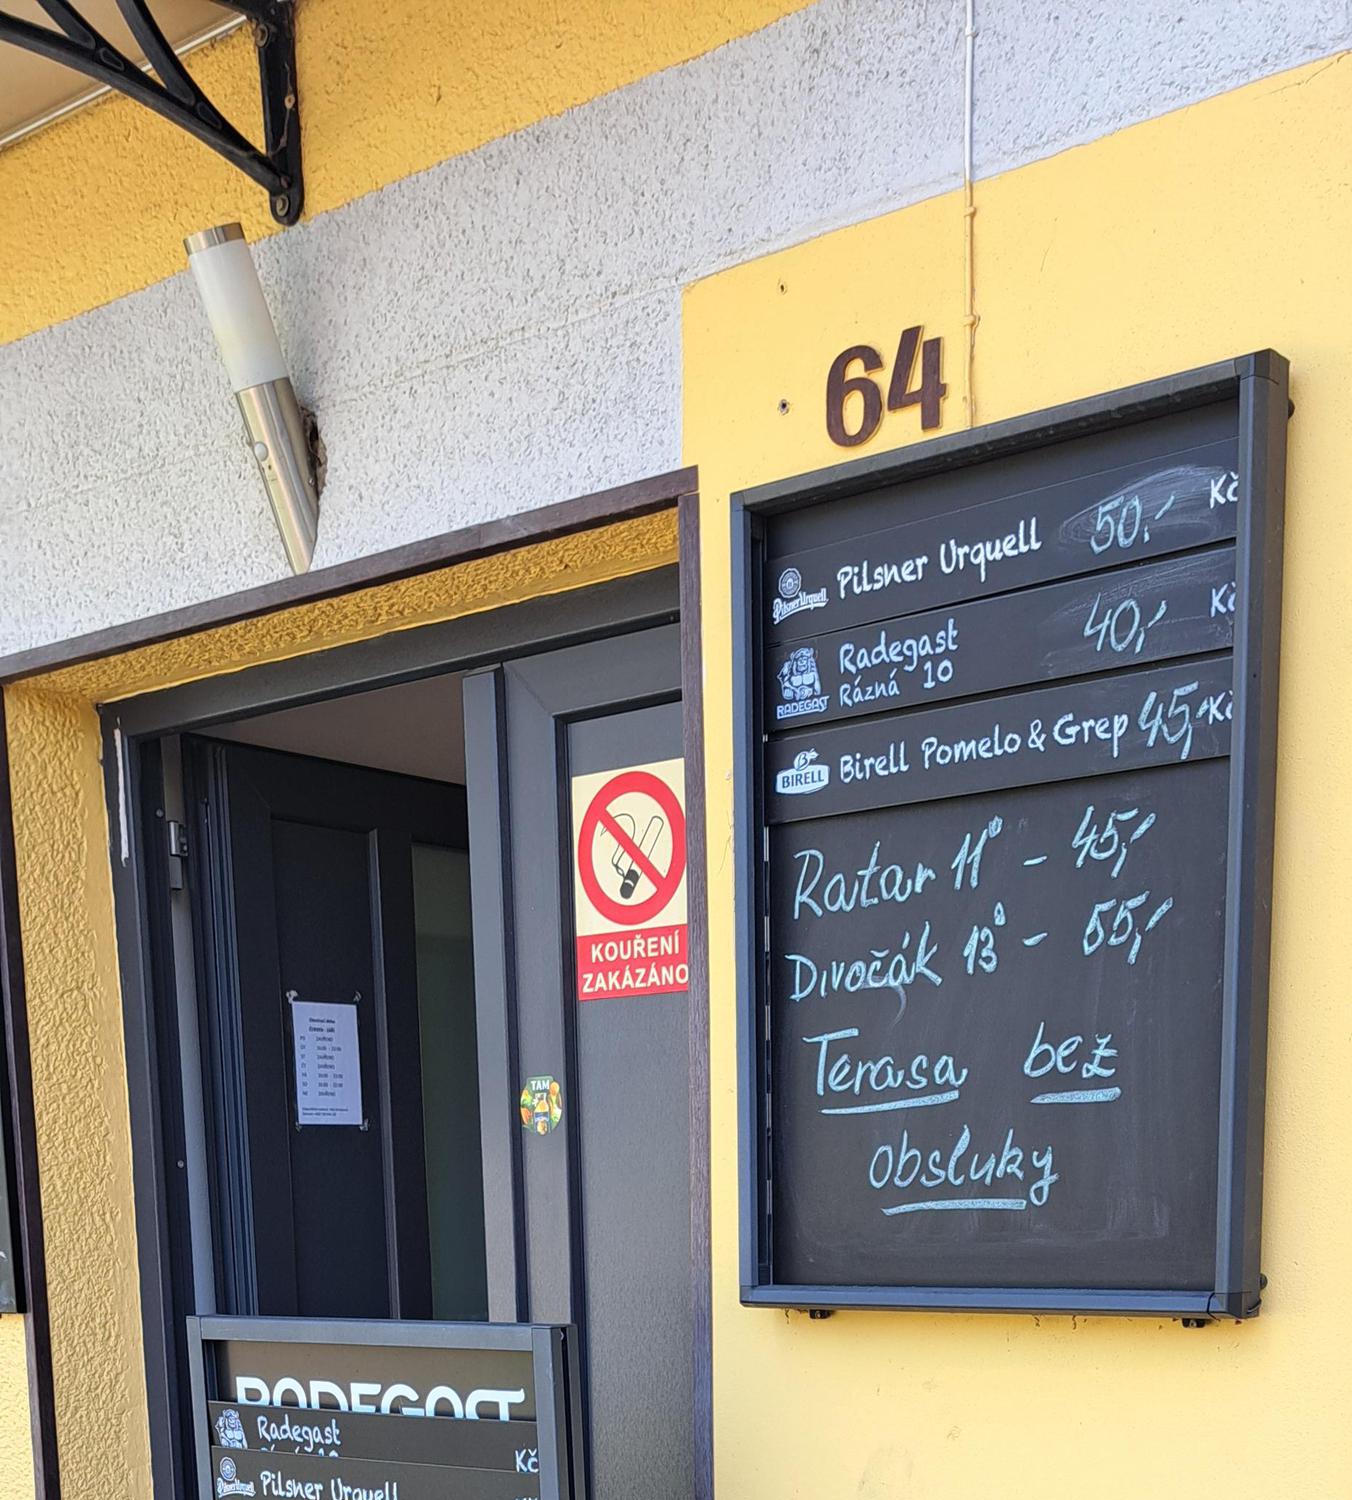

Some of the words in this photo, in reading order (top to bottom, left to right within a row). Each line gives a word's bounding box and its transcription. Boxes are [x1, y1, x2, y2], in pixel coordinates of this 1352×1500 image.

[825, 325, 949, 447] 64
[837, 554, 928, 600] Pilsner
[939, 517, 1042, 582] Urquell
[1209, 471, 1239, 509] Kč
[838, 618, 959, 675] Radegast
[776, 695, 830, 719] RADEGAST
[838, 677, 901, 708] Rázná
[922, 664, 954, 690] 10
[839, 745, 909, 784] Birell
[922, 728, 1021, 770] Pomelo
[1027, 727, 1048, 754] &
[1053, 713, 1129, 758] Grep
[782, 770, 825, 790] BIRELL
[792, 840, 936, 920] Ratar
[591, 929, 680, 964] KOUŘENÍ
[784, 921, 943, 1002] Divočák
[582, 962, 689, 994] ZAKÁZÁNO
[530, 1079, 550, 1091] TAM
[802, 1027, 968, 1096] Terasa
[1023, 1021, 1120, 1079] bez
[257, 1414, 341, 1454] Radegast
[515, 1448, 540, 1473] Kč
[260, 1470, 323, 1500] Pilsner
